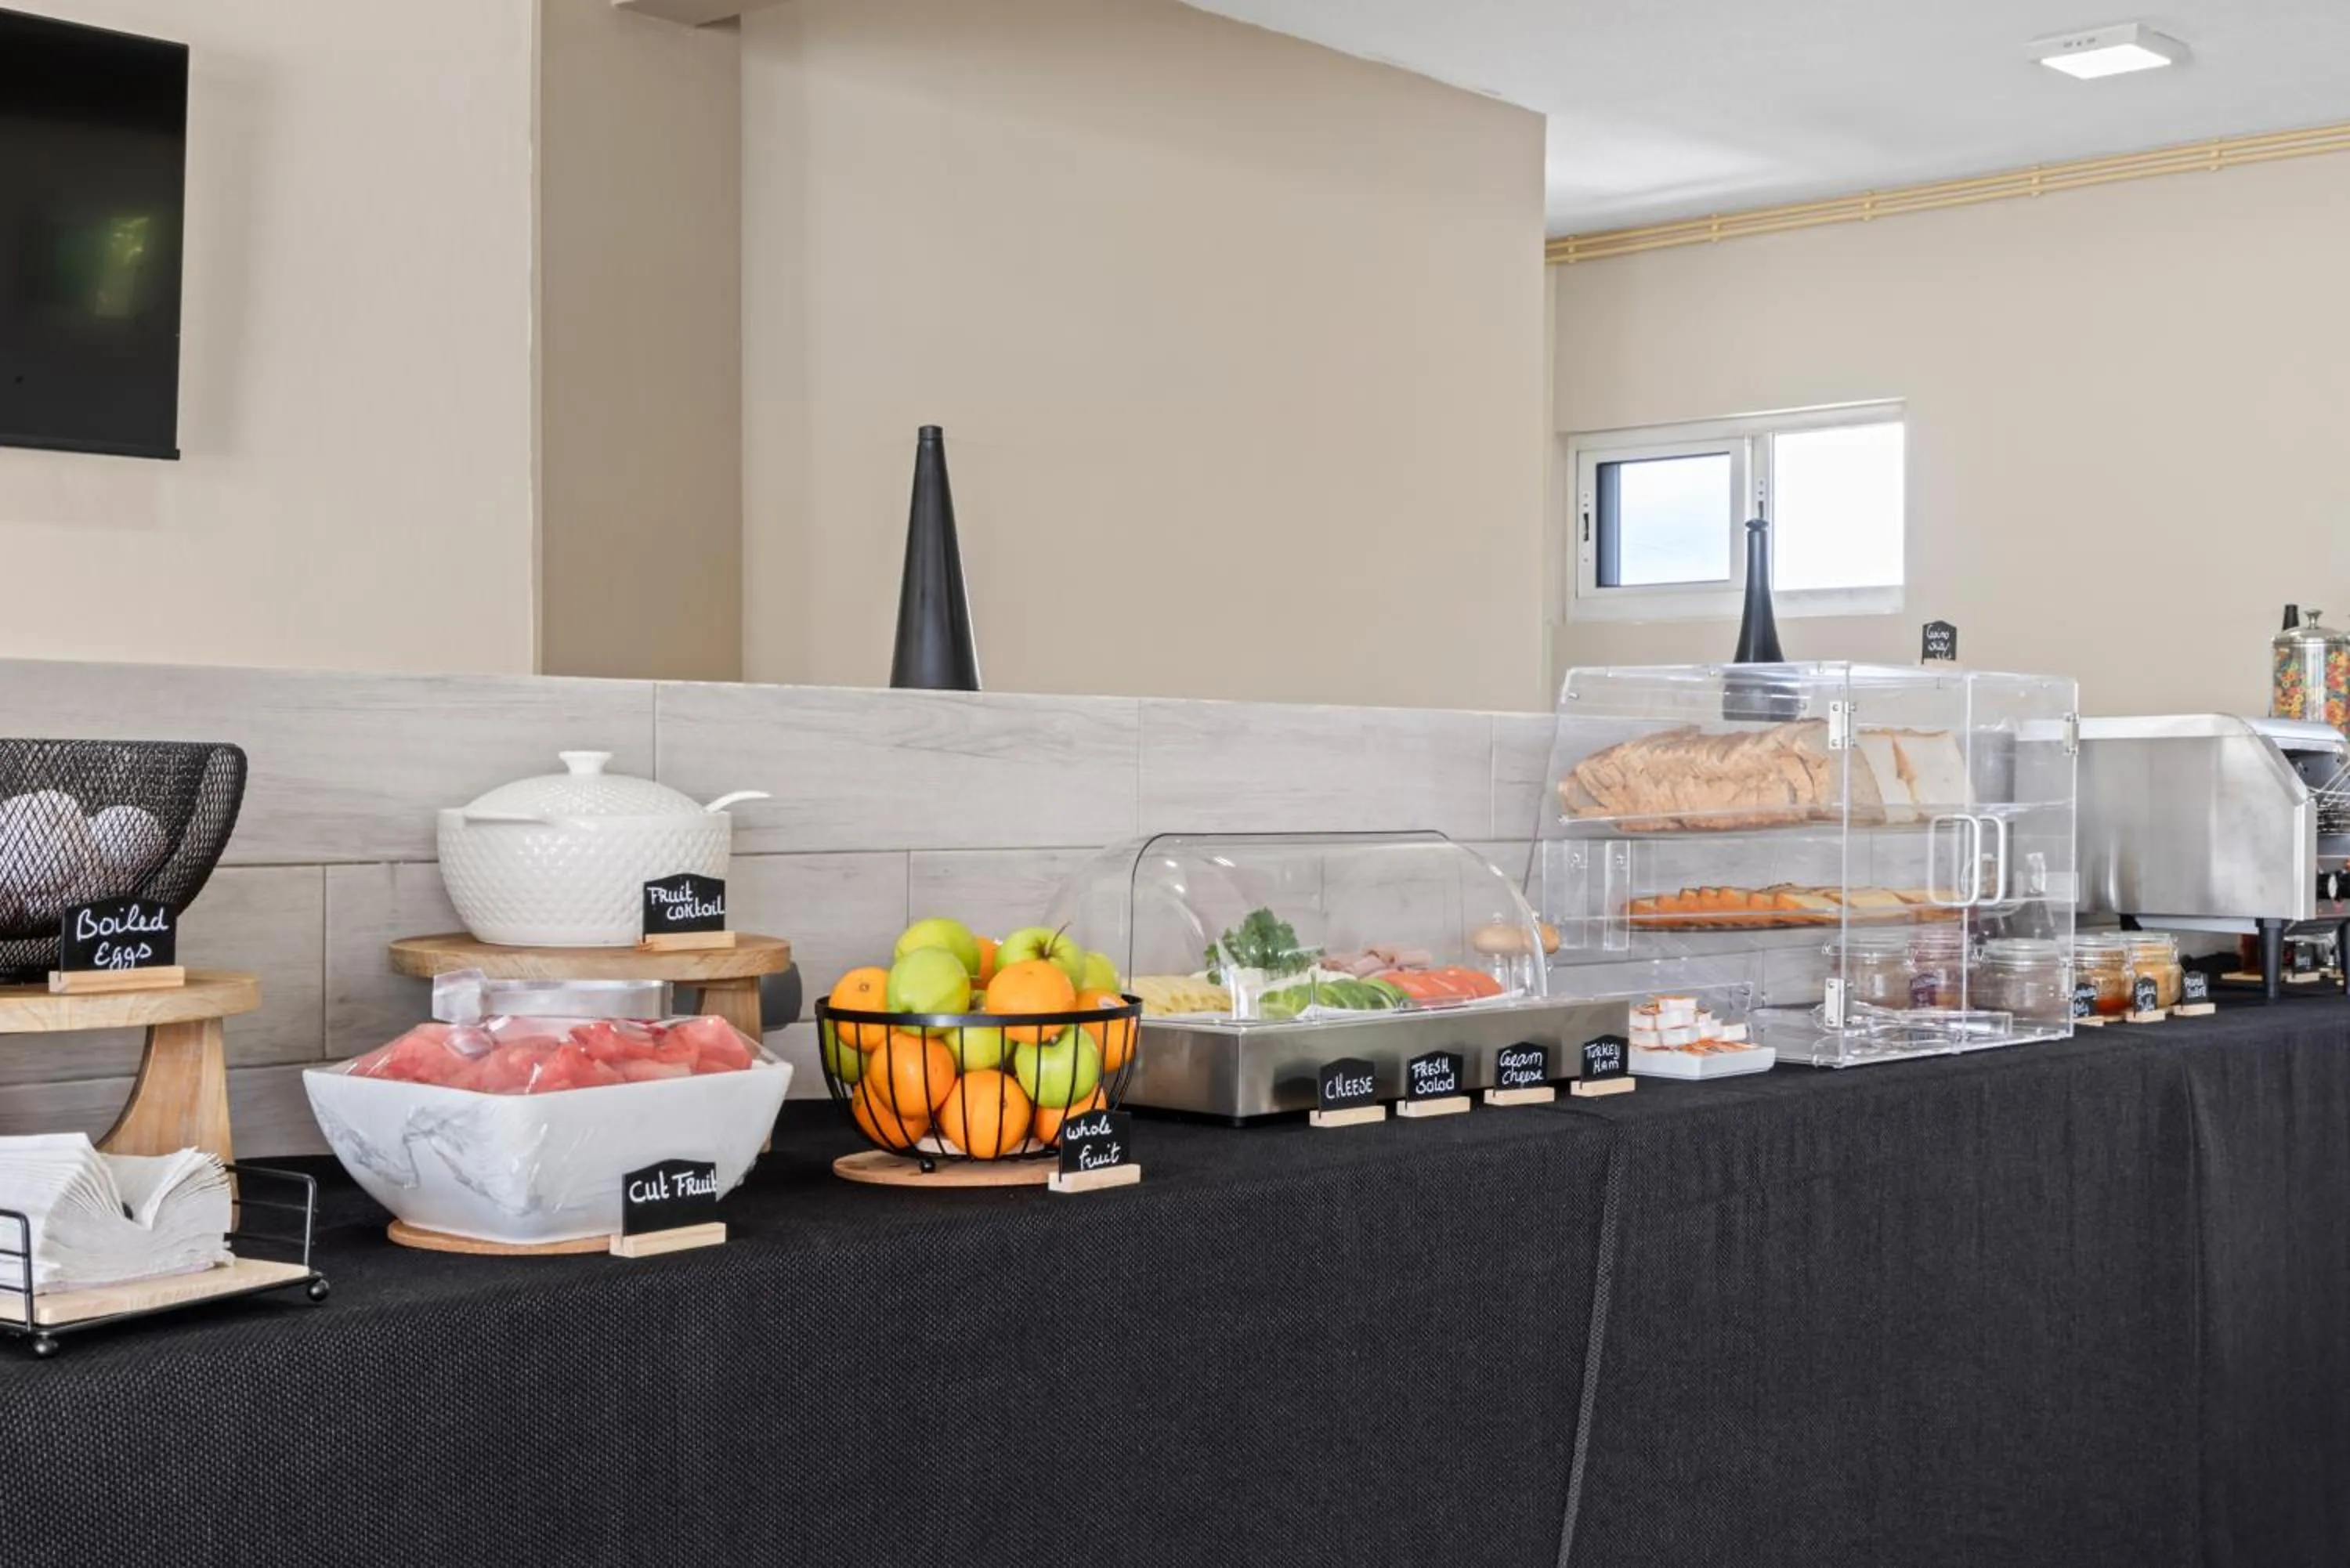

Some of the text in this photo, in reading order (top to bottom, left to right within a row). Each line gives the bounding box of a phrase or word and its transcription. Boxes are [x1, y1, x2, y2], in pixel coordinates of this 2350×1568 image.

[76, 903, 170, 941] Boiled
[93, 941, 153, 972] Eggs
[1325, 1072, 1374, 1100] CHEESE
[628, 1169, 671, 1203] Cut
